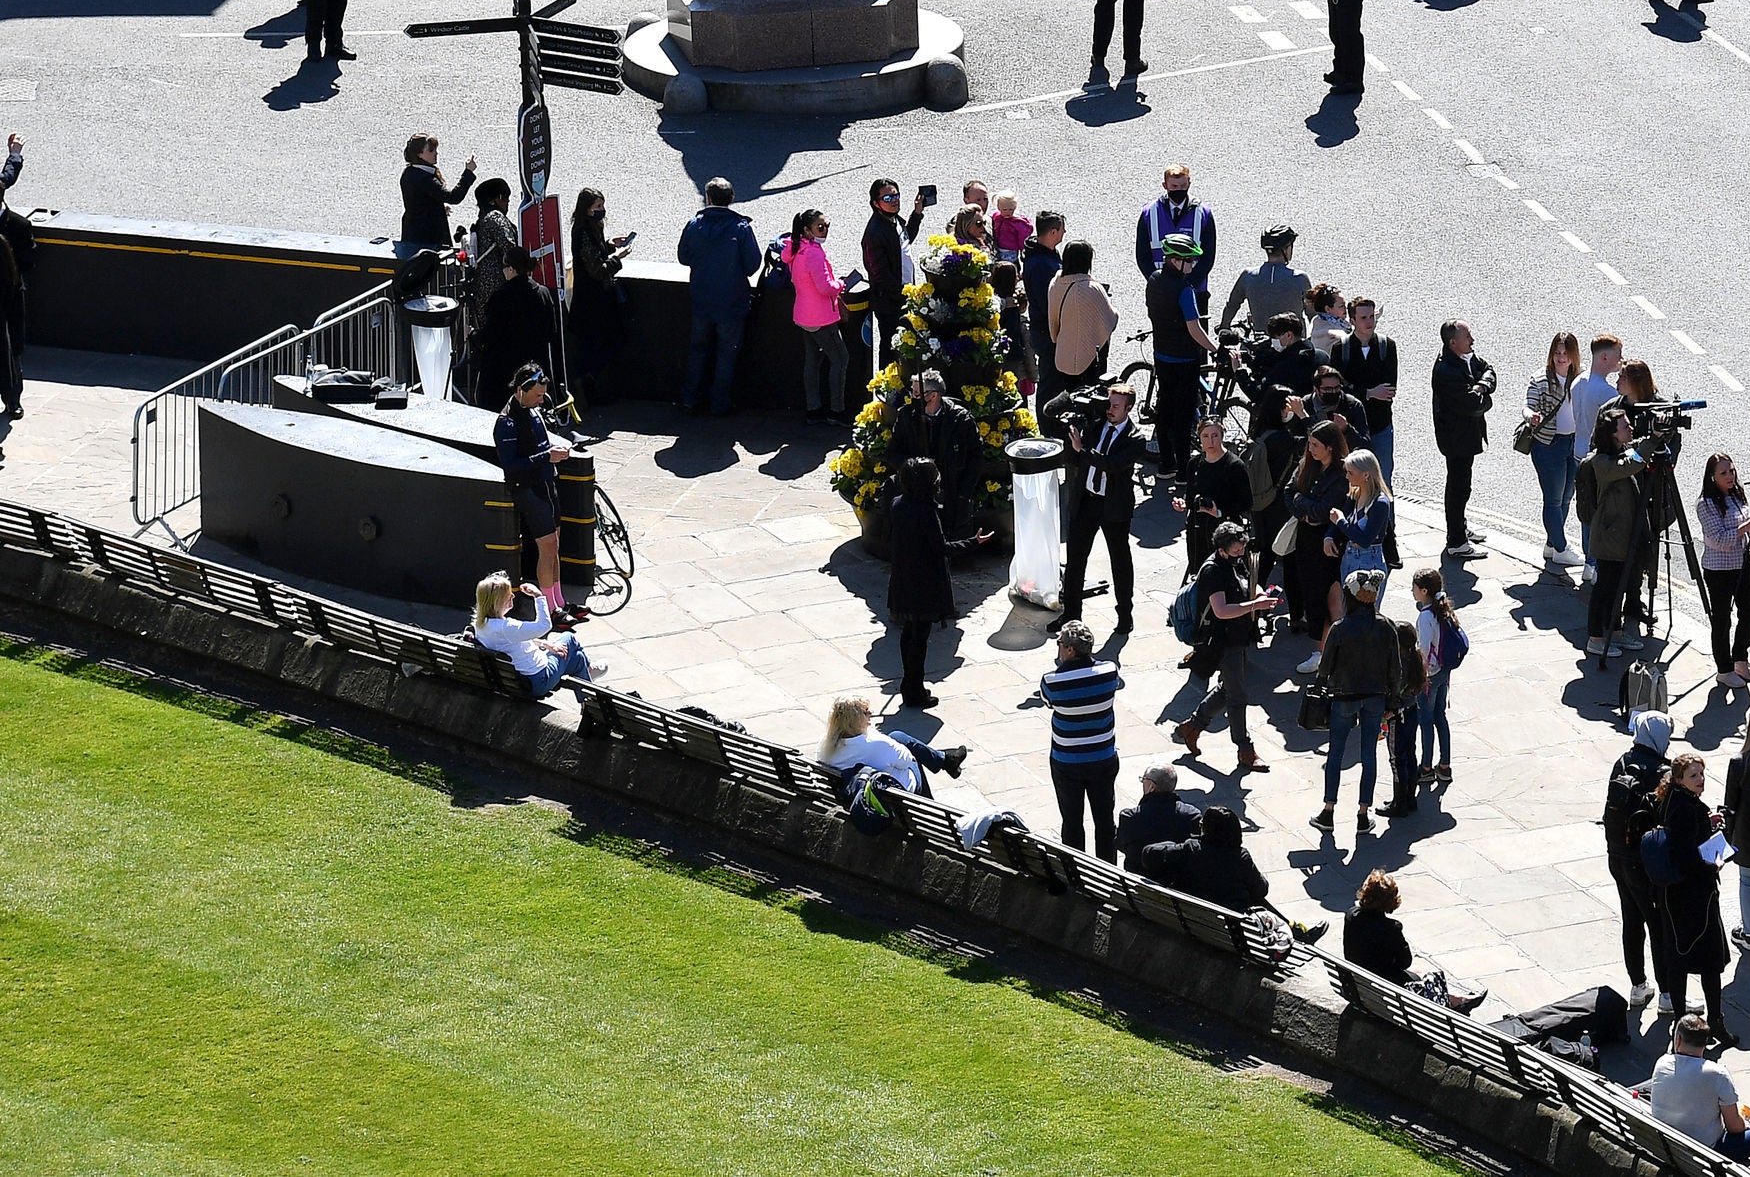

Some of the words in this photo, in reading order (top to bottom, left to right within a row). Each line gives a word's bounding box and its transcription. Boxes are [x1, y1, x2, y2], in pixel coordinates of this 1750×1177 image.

[430, 25, 453, 33] Windsor
[454, 24, 470, 32] Castle
[530, 113, 543, 123] DON'T
[531, 136, 544, 146] YOUR
[530, 147, 546, 158] GUARD
[530, 158, 546, 170] DOWN
